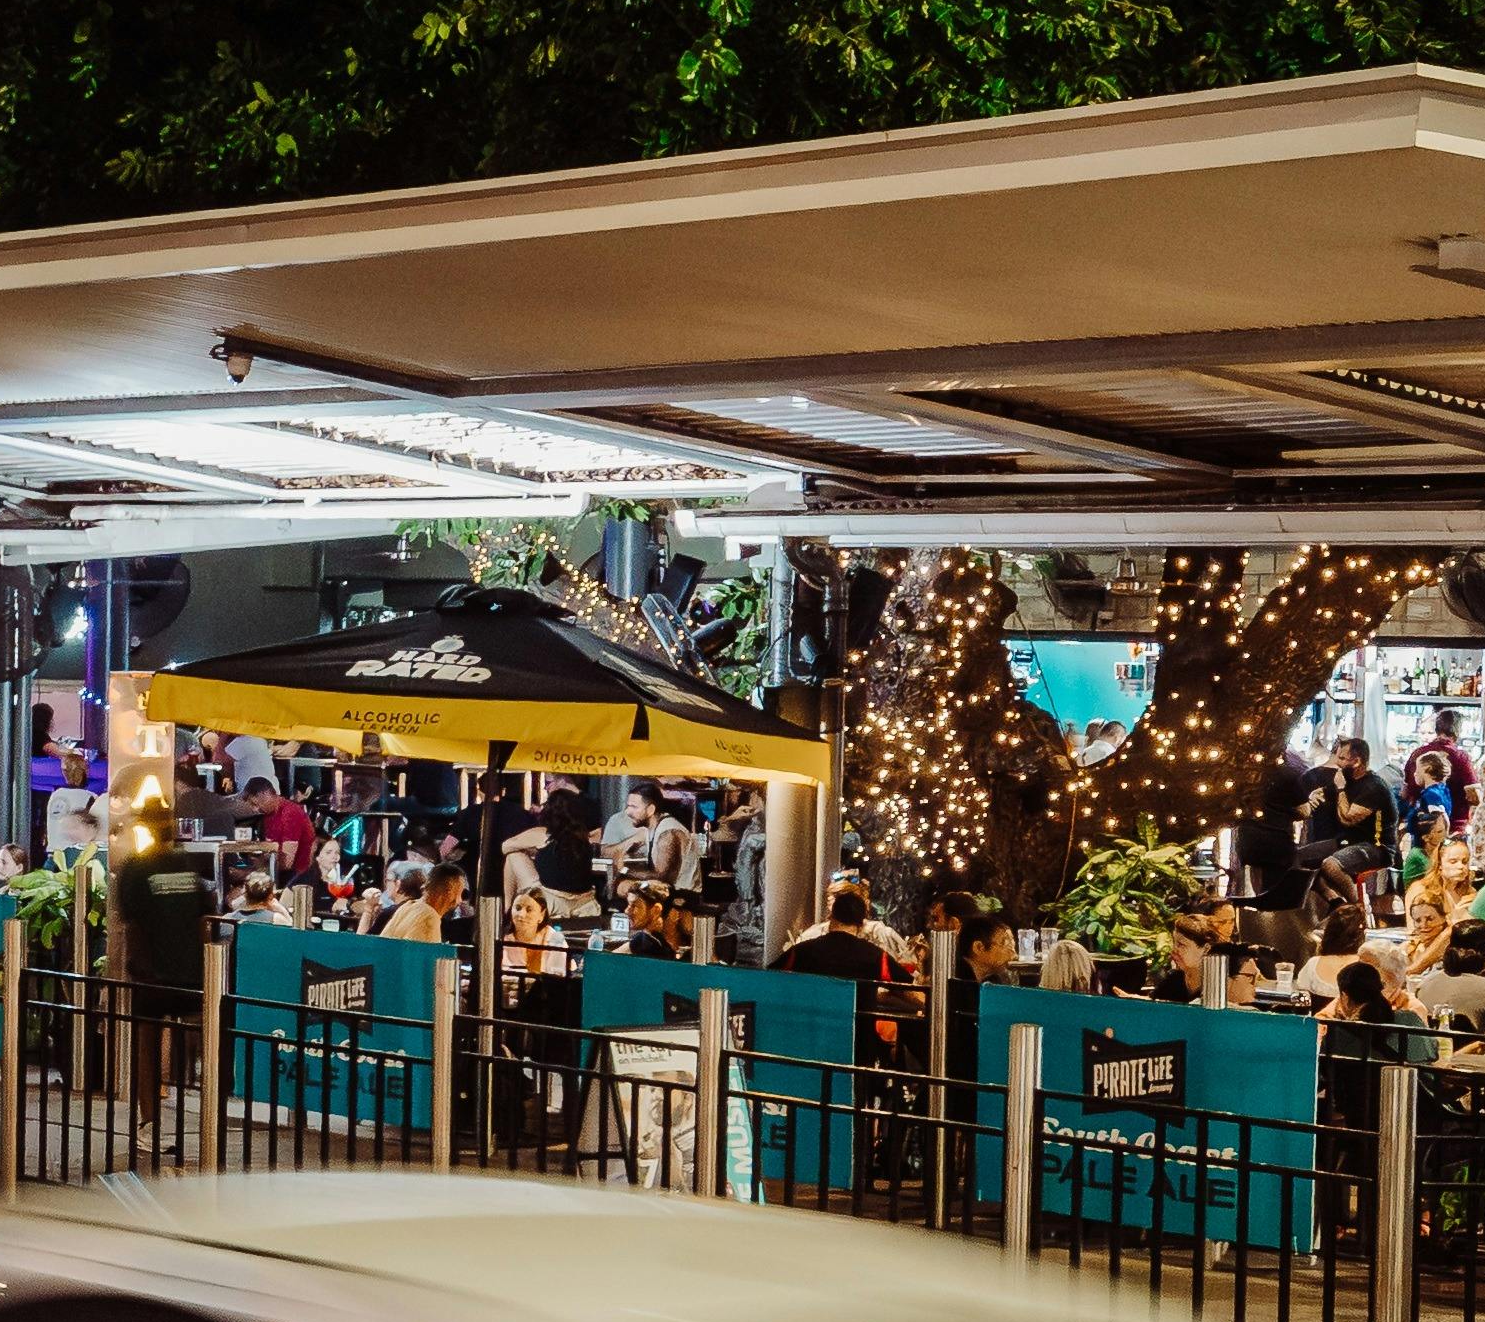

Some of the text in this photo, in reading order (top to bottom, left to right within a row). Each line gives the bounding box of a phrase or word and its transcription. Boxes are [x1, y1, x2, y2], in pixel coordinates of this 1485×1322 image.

[388, 650, 482, 666] HARD
[345, 659, 492, 683] RATED
[342, 709, 441, 725] ALCOHOLIC
